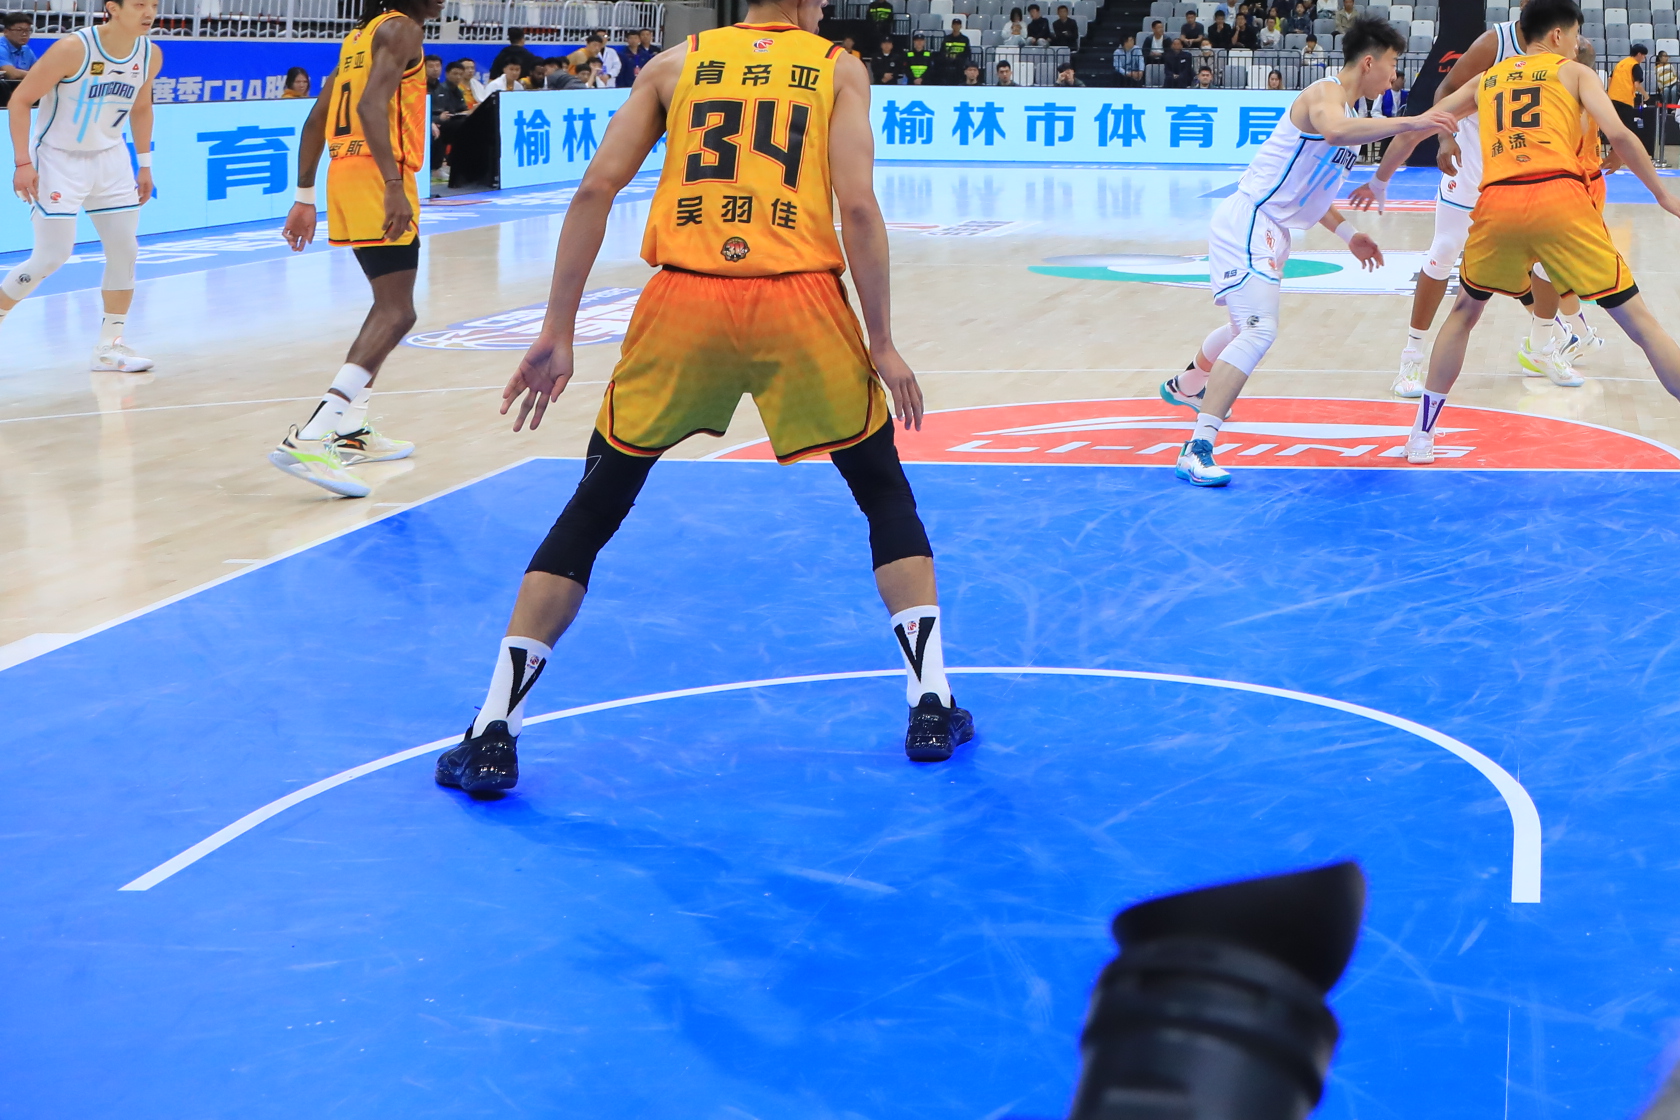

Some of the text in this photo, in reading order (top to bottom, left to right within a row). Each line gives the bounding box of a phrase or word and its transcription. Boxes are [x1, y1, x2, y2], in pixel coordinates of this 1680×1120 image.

[88, 81, 136, 99] QINGDAO
[694, 60, 821, 92] 肯帝亚
[1484, 70, 1548, 91] 肯帝亚
[112, 109, 129, 128] 7
[335, 82, 352, 138] 0
[881, 99, 1288, 149] 榆林市体育局
[1493, 83, 1543, 134] 12
[681, 97, 812, 193] 34
[676, 195, 798, 229] 吴羽佳
